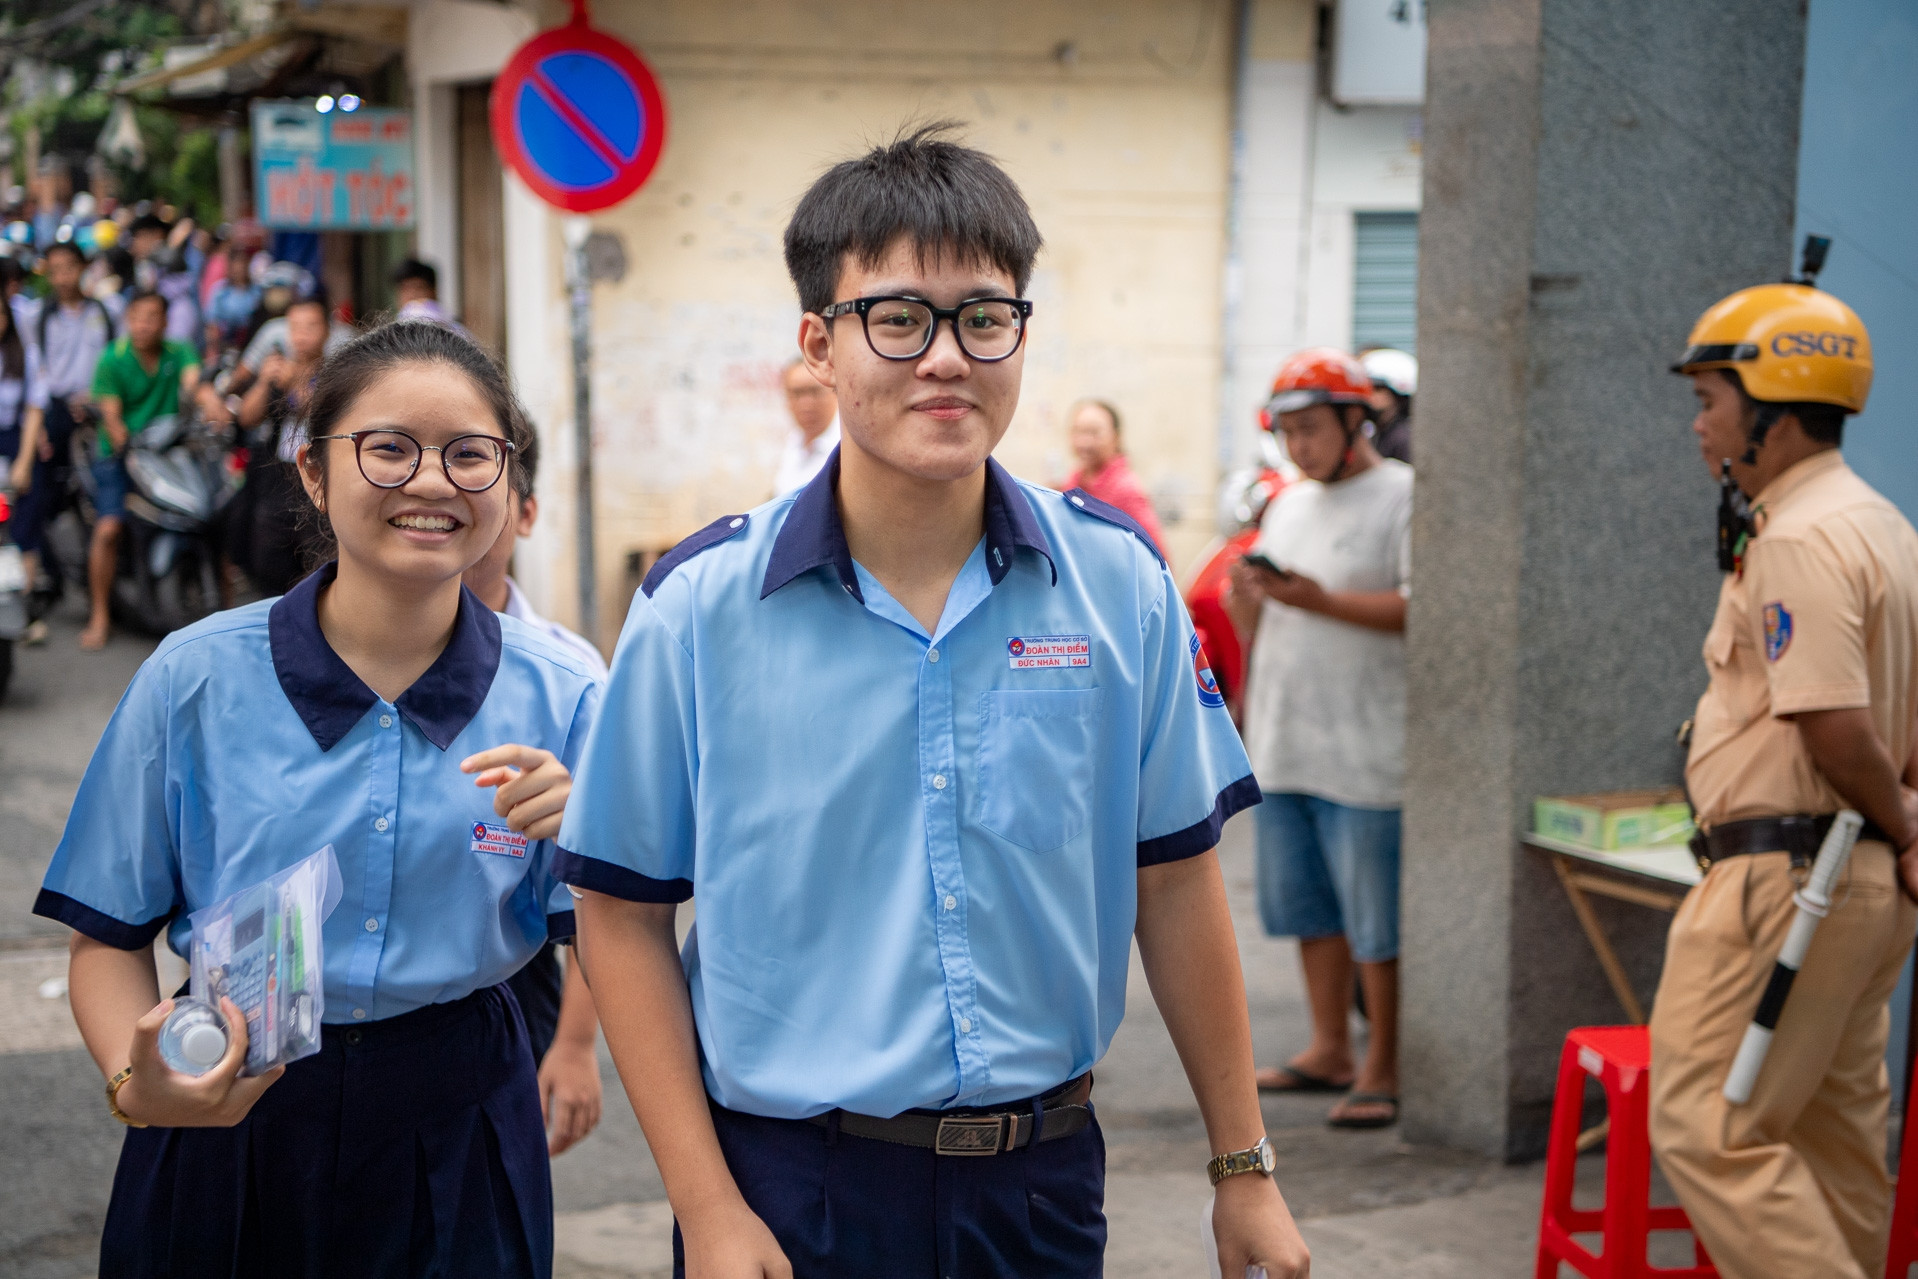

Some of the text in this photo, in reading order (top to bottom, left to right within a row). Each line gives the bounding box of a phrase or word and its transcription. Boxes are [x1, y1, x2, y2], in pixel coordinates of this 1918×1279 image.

[1771, 331, 1857, 359] CSGT
[1026, 642, 1088, 655] ĐOÀN THỊ ĐIỂM
[1018, 658, 1035, 667] ĐỨC
[1037, 658, 1060, 666] NHÂN
[486, 833, 502, 841] ĐOÀN
